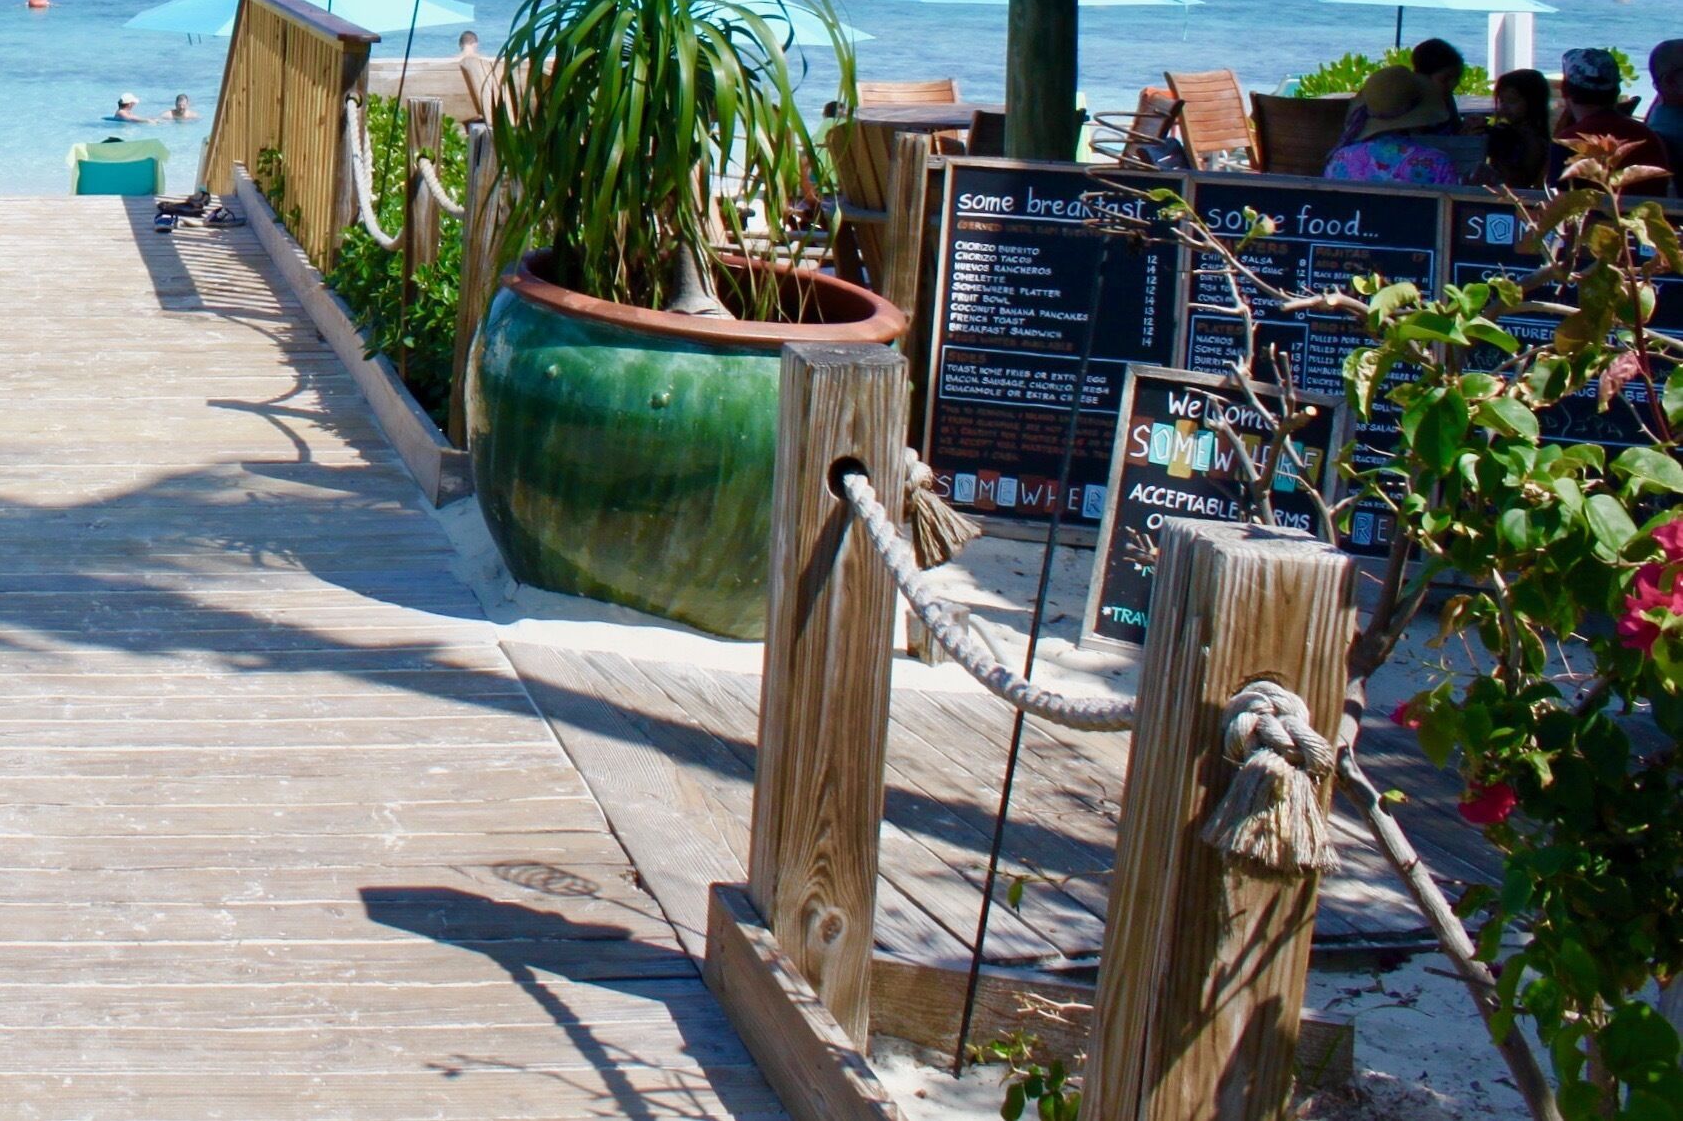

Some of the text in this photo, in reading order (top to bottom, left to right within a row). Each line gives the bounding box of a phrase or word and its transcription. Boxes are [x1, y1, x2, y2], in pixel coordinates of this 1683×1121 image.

[957, 193, 1015, 212] some
[954, 240, 1041, 256] CHORIZO BURRITO
[954, 251, 1033, 264] CHORIZO TACOS
[1146, 254, 1158, 265] 12
[954, 262, 1052, 276] HUEVOS RANCHEROS
[1146, 265, 1156, 275] 14
[952, 272, 1006, 284] OMELETTE
[1146, 275, 1157, 285] 12
[952, 282, 1062, 298] SOMEWHERE PLATTER
[1145, 285, 1156, 295] 12
[951, 292, 1011, 305] FRUIT BOWL
[1145, 295, 1155, 306] 14
[950, 303, 1089, 322] COCONUT BANANA PANCAKES
[950, 313, 1026, 326] FRENCH TOAST
[1143, 317, 1154, 327] 12
[948, 322, 1063, 339] BREAKFAST SANDWICH
[1050, 372, 1081, 383] EXTR
[1078, 385, 1110, 396] RESH
[1059, 392, 1100, 405] CHESE
[936, 473, 1106, 516] SOMEWHER
[1128, 483, 1239, 520] ACCEPTABLE
[1146, 513, 1164, 530] O
